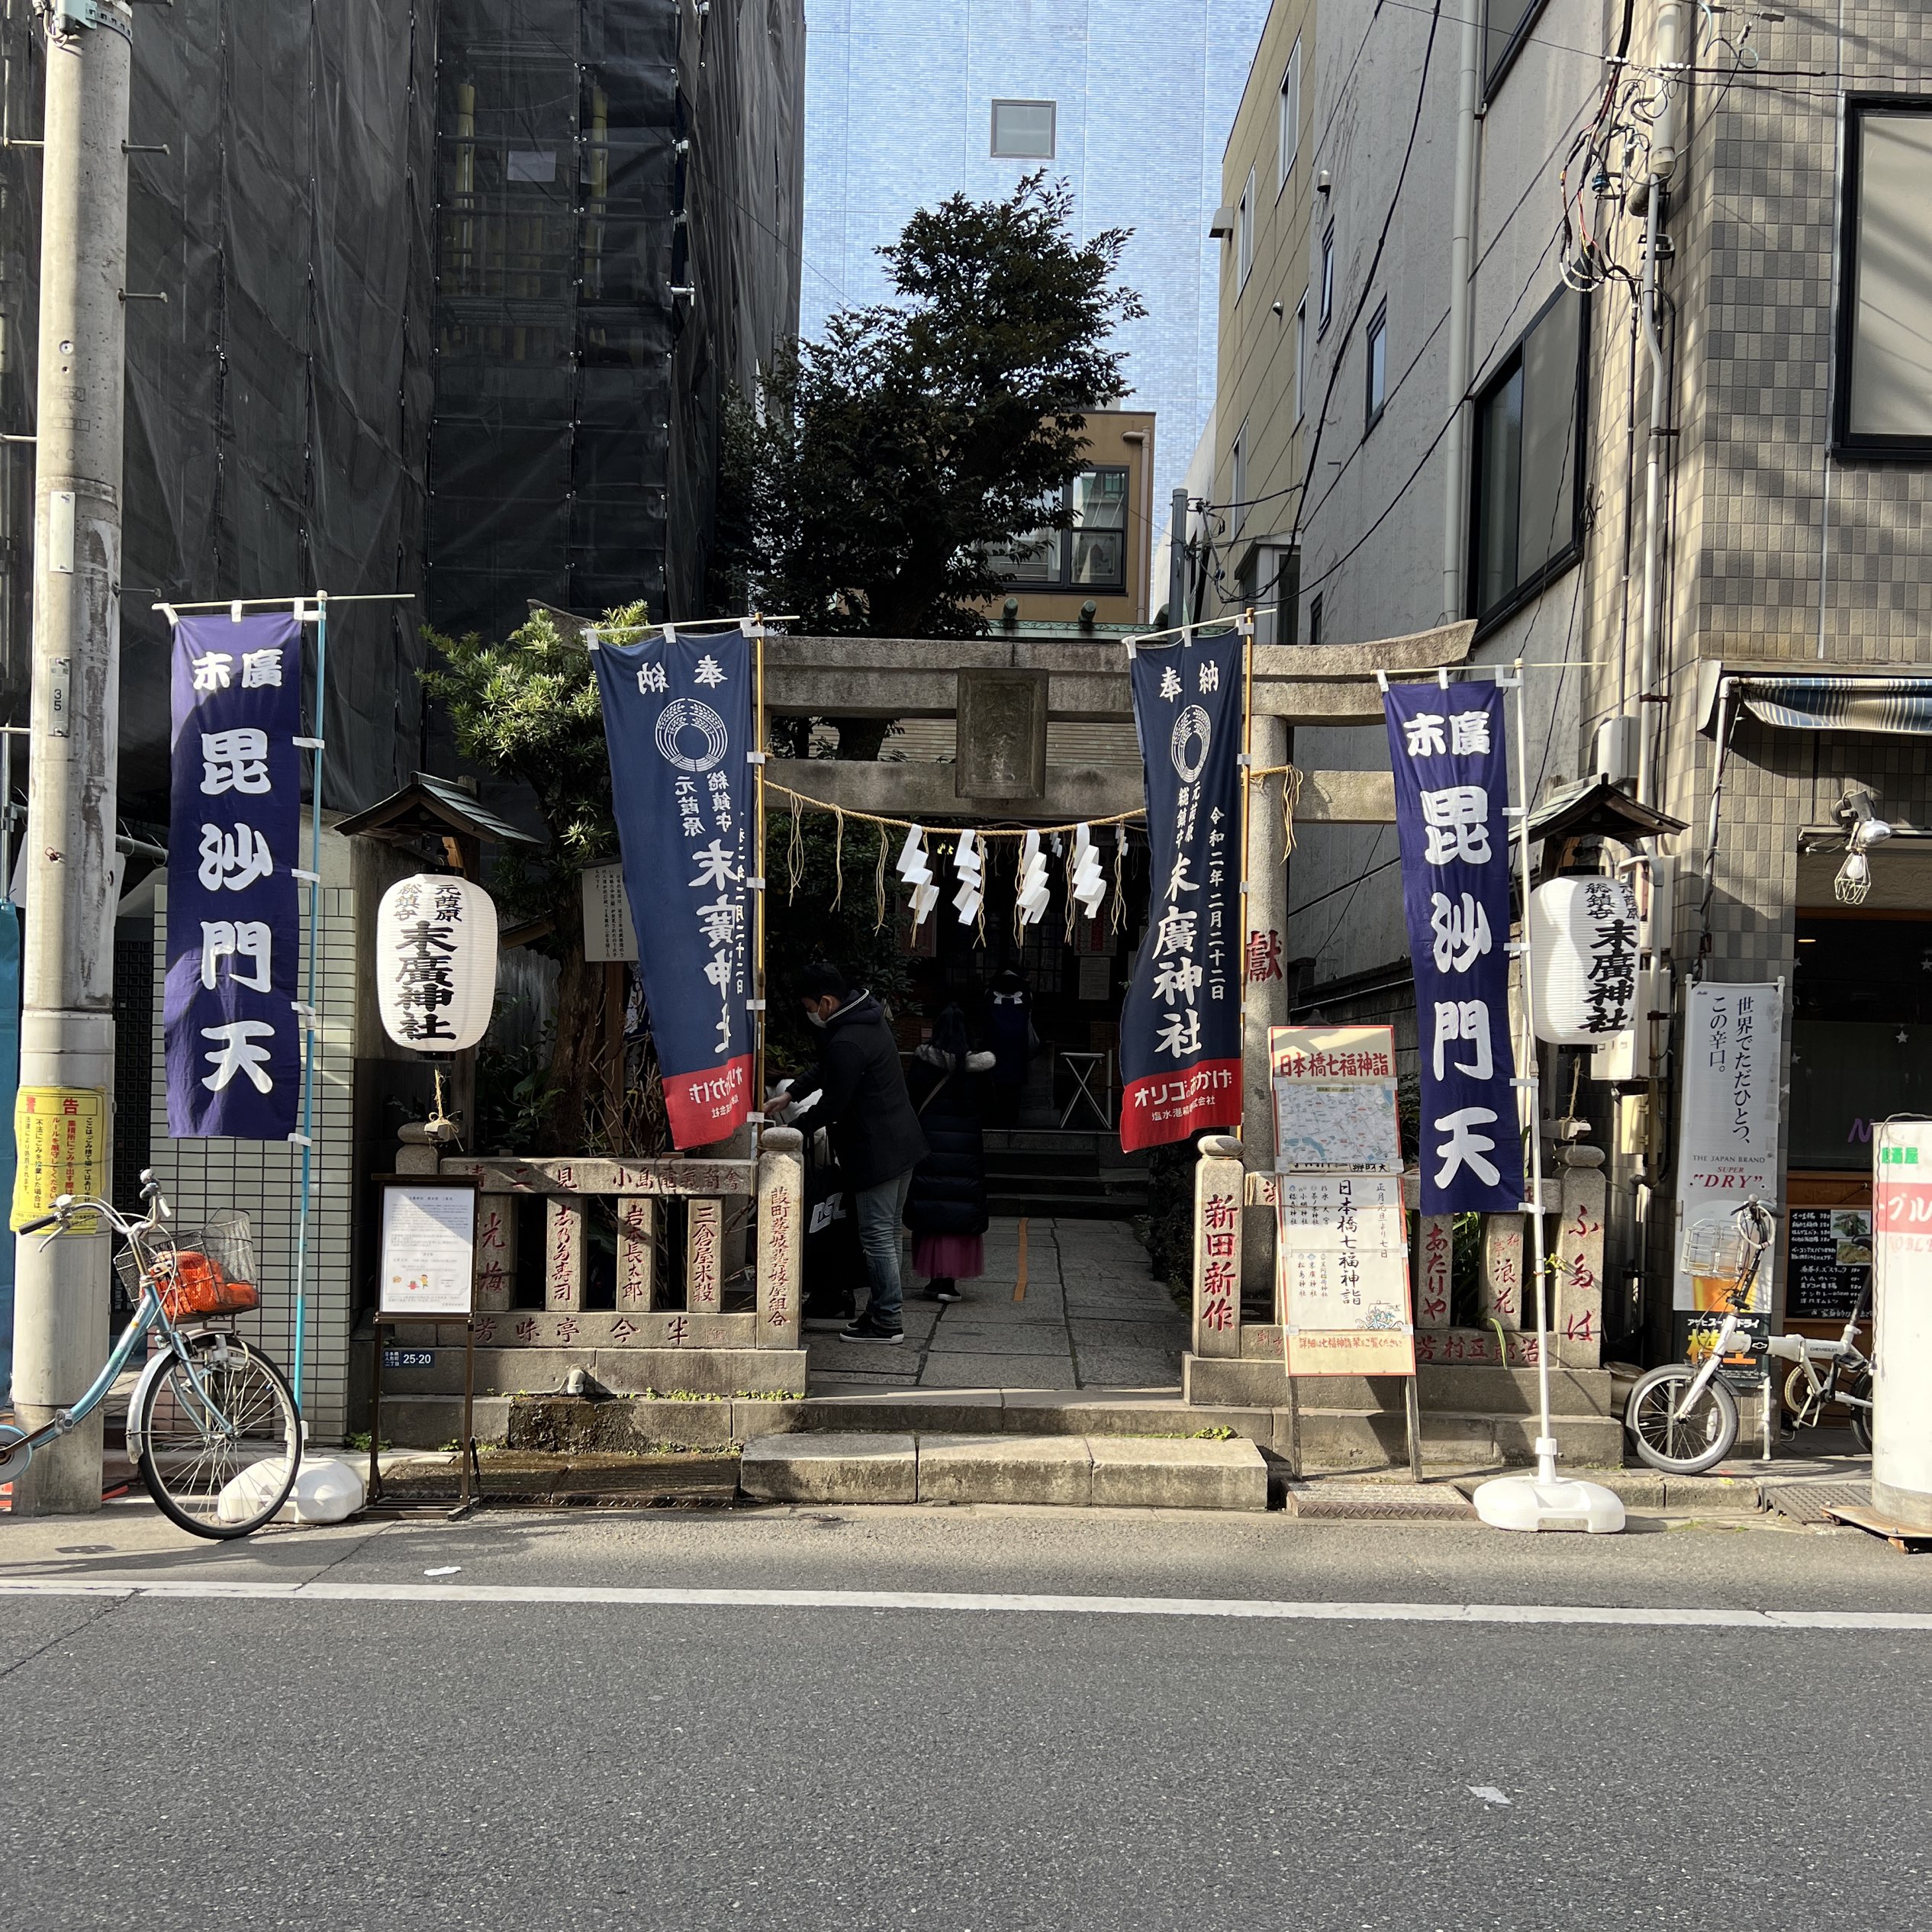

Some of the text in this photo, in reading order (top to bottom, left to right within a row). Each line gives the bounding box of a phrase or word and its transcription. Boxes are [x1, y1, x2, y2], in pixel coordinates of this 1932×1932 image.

[192, 649, 283, 689] 末廣
[1159, 659, 1219, 703] 奉納
[1403, 710, 1491, 757] 末廣
[198, 727, 275, 1094] 毘沙門天
[1208, 806, 1225, 1000] 令和二年二月二十二日
[393, 919, 458, 1041] 末廣神社
[1151, 852, 1204, 1059] 末廣神社
[1419, 785, 1501, 1190] 毘沙門天
[1577, 919, 1639, 1034] 末廣神社
[1280, 1051, 1389, 1078] 日本橋七福神詣
[1709, 996, 1728, 1073] この辛口。
[1732, 995, 1754, 1145] 世界でただひとつ、
[1202, 1194, 1240, 1333] 新田新作
[1337, 1180, 1361, 1306] 日本橋七福神詣
[1423, 1222, 1448, 1321] あたりや
[1493, 1258, 1516, 1314] 浪花
[403, 1354, 431, 1364] 25-20
[610, 1316, 689, 1346] 今半
[1687, 1318, 1760, 1328] アサヒスードライ
